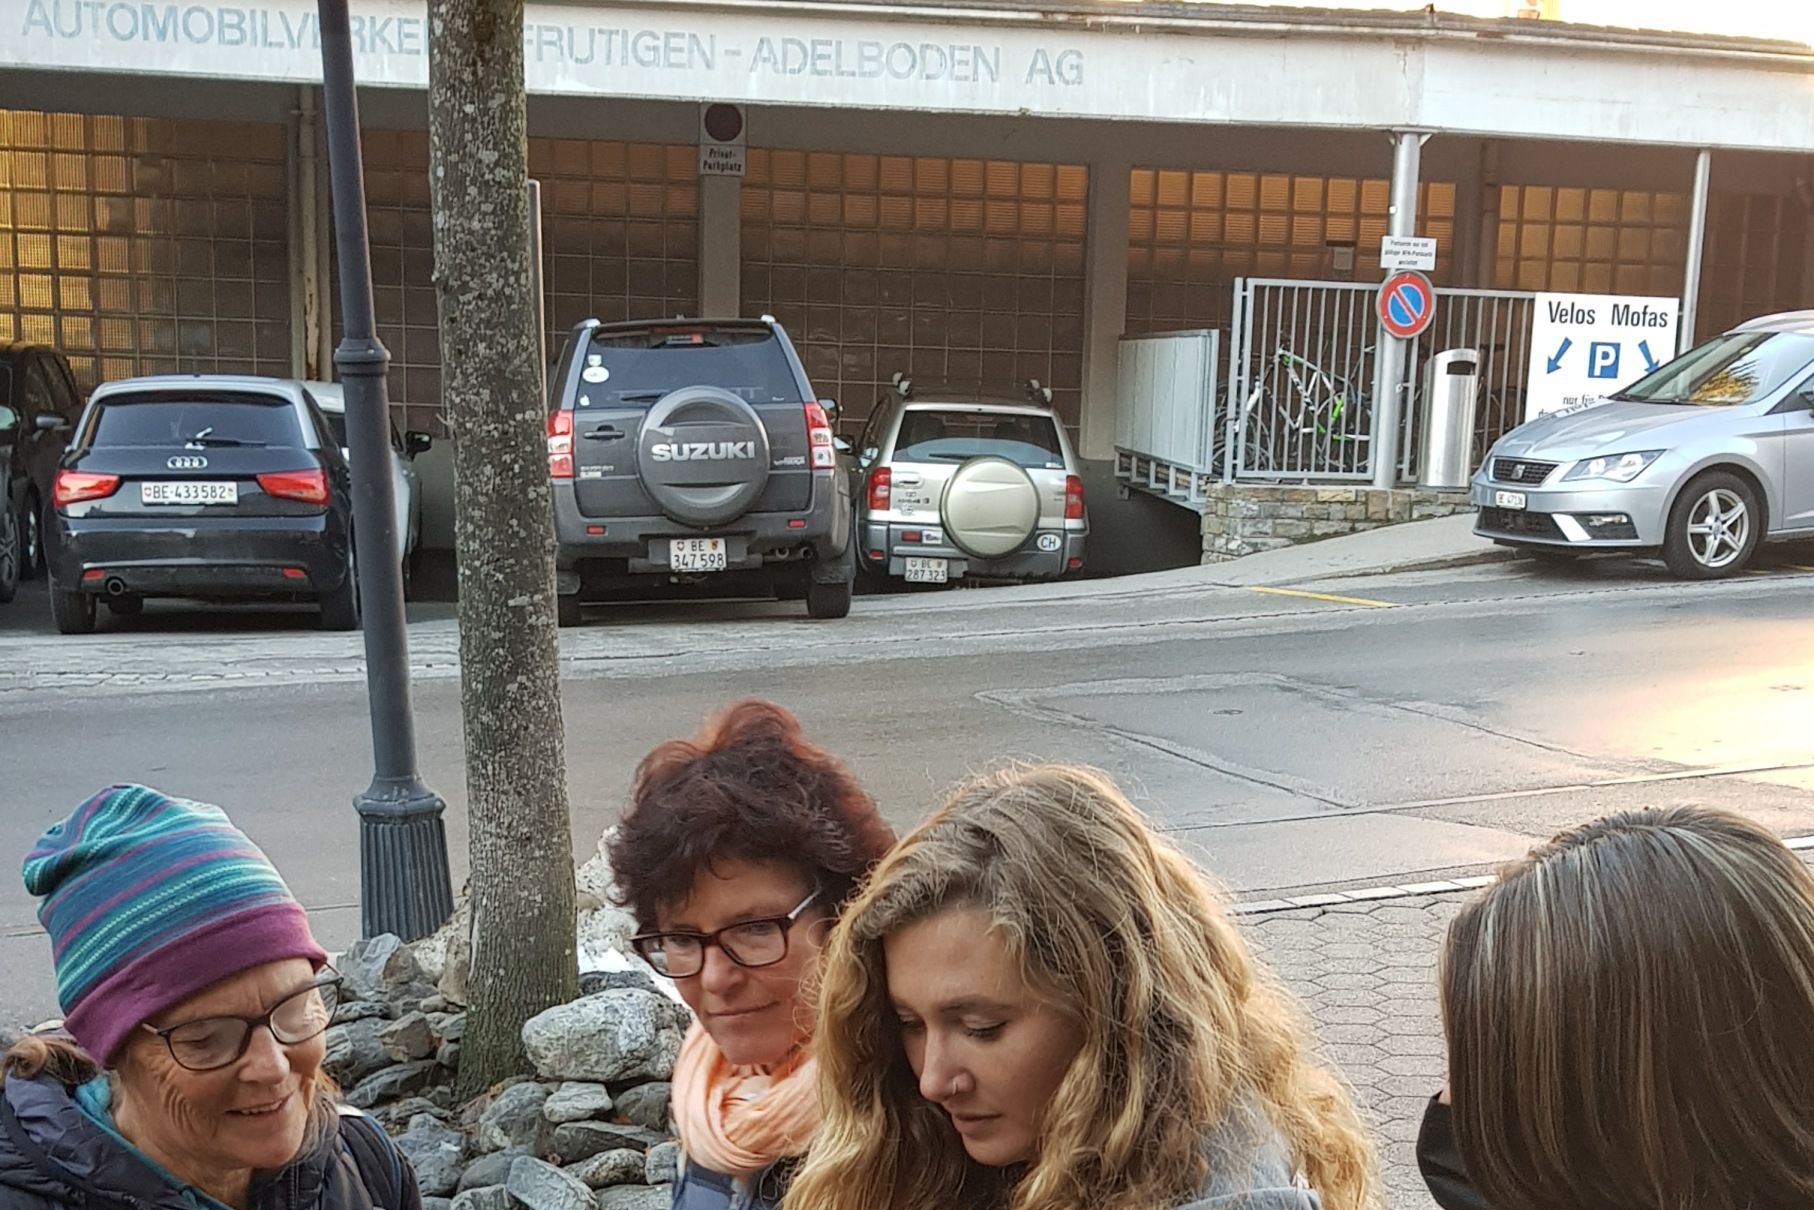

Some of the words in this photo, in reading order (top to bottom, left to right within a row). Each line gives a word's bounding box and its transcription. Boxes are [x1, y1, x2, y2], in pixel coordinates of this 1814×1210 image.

[22, 0, 428, 55] AUTOMOBILVRKE
[1025, 48, 1084, 86] AG
[703, 160, 742, 172] Parkplatz
[1548, 301, 1596, 325] Velos
[1611, 303, 1668, 328] Mofas
[1593, 345, 1617, 377] P
[651, 441, 756, 462] SUZUKI
[691, 541, 704, 551] BE
[1040, 536, 1057, 549] CH
